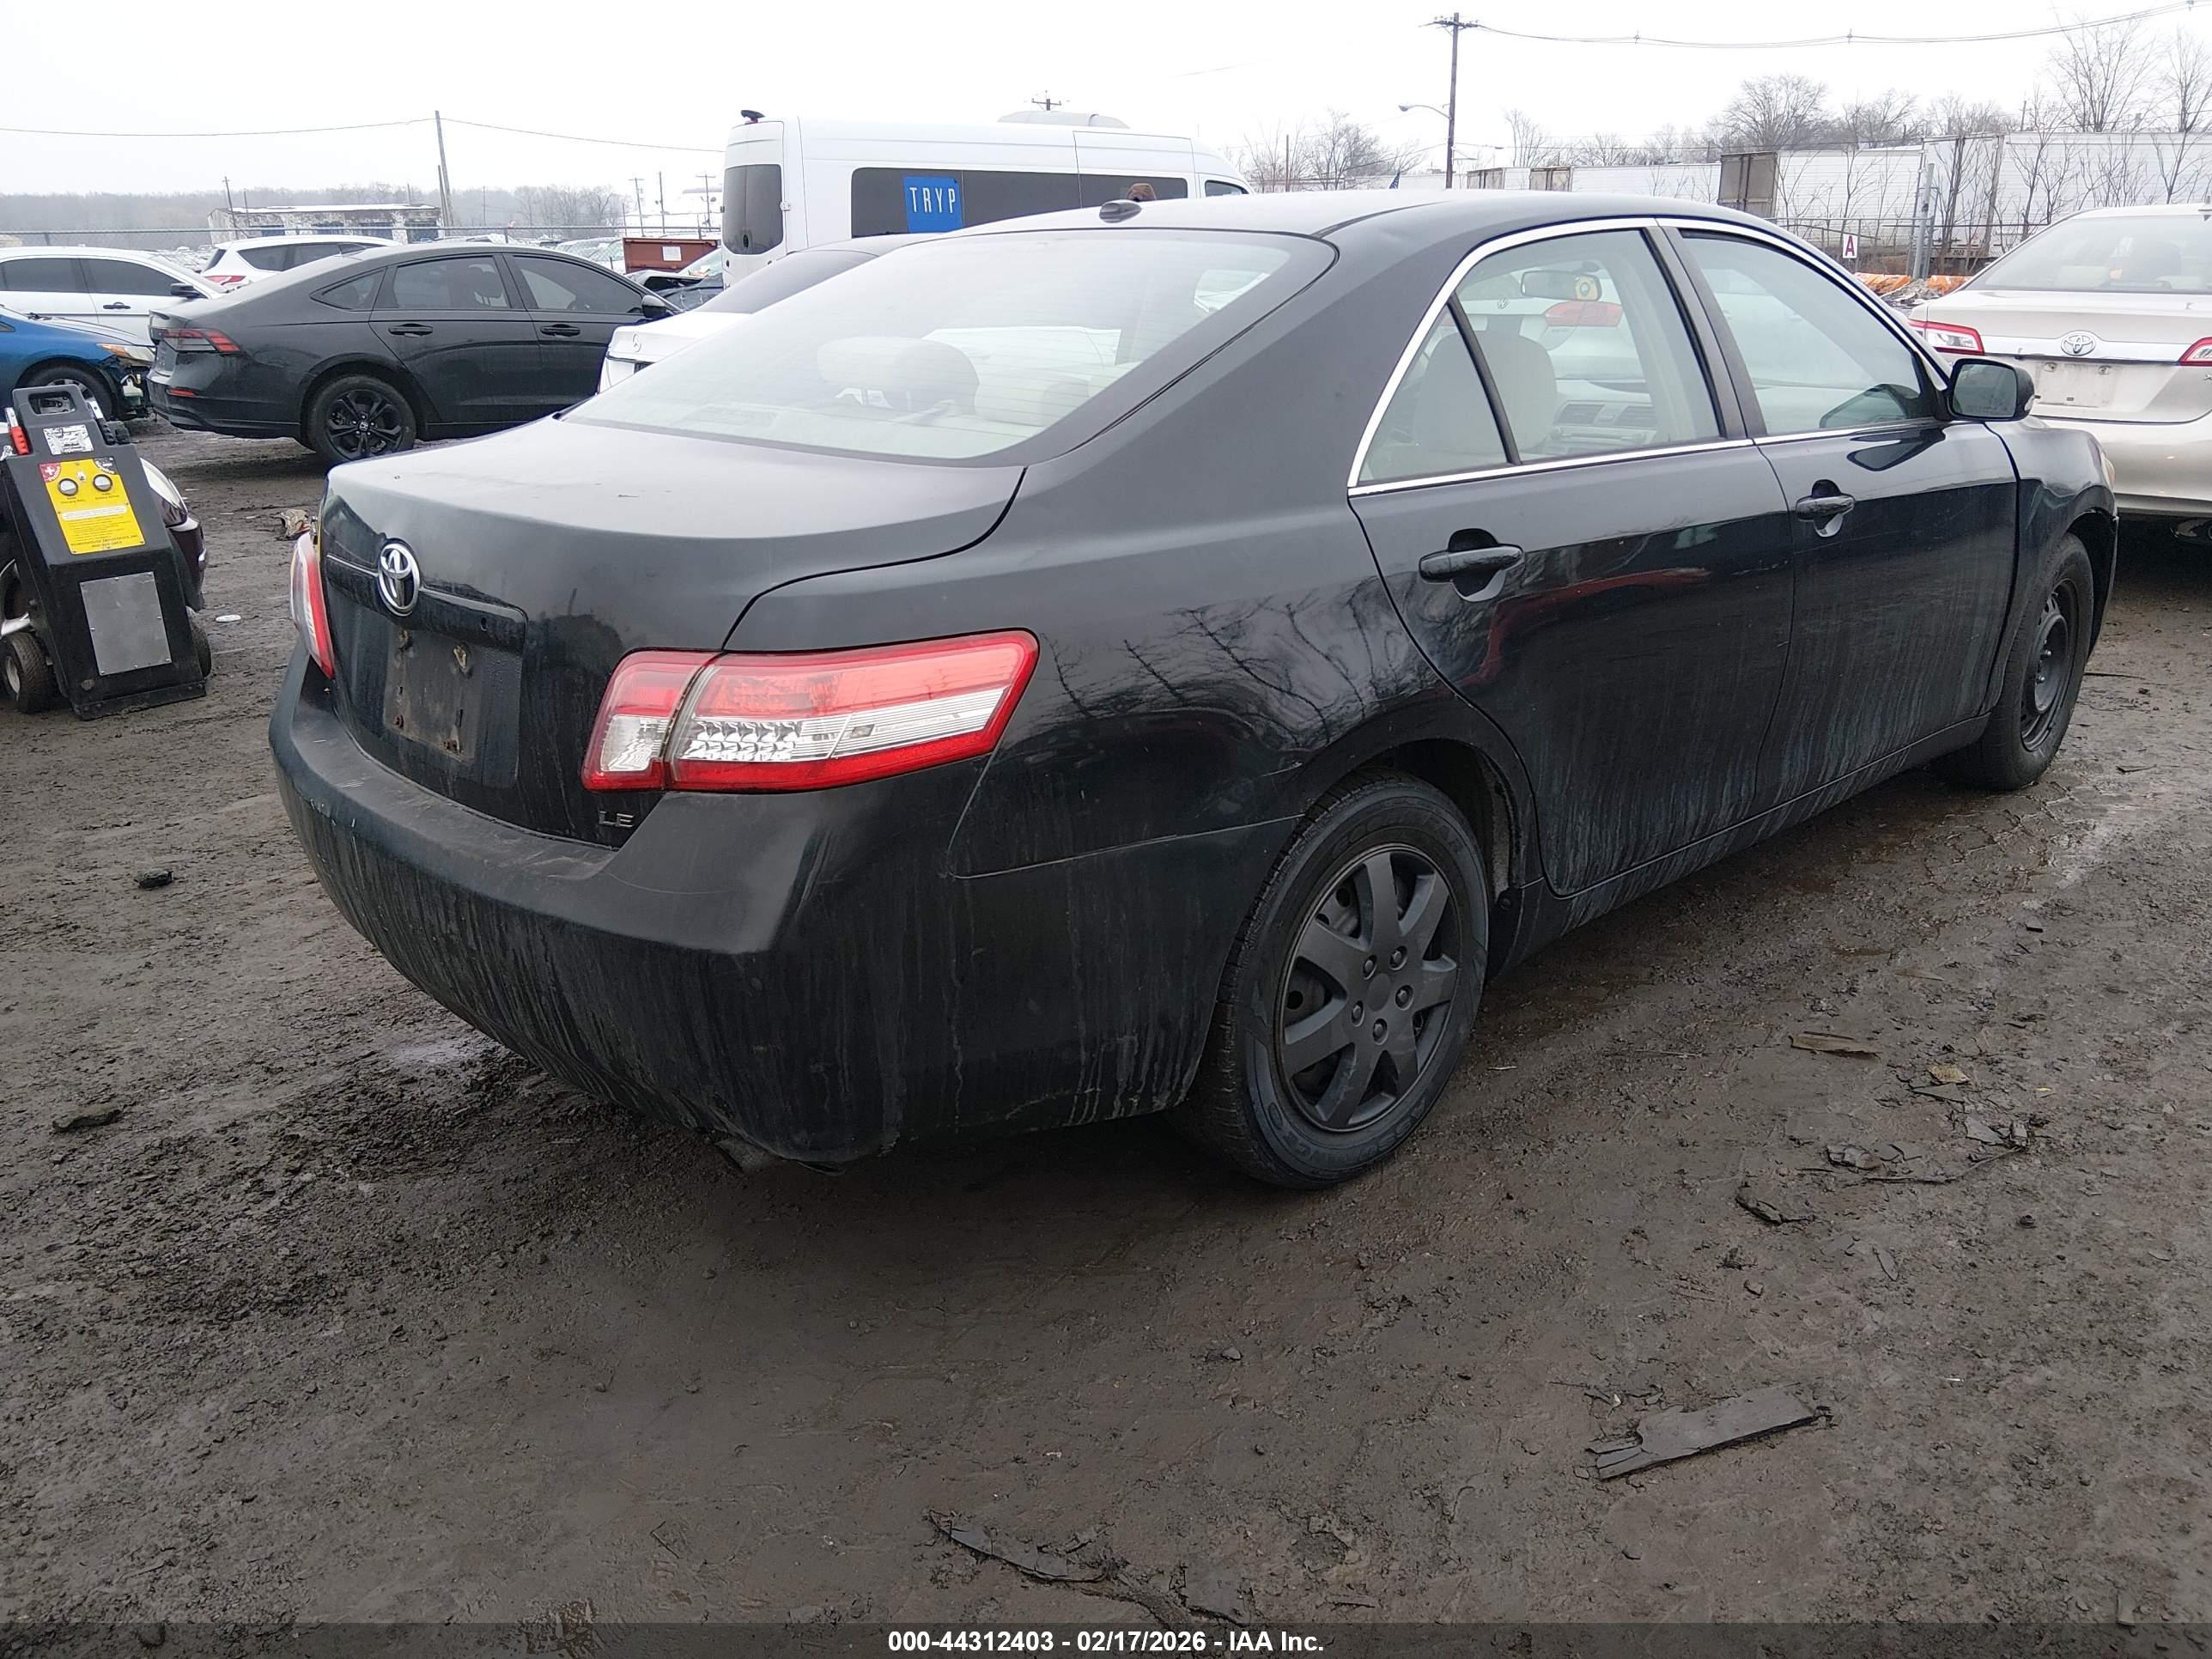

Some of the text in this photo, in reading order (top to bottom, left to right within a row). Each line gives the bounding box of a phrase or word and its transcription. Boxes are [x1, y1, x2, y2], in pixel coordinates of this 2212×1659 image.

[909, 186, 956, 214] TRYP
[1844, 235, 1855, 257] A
[599, 811, 634, 828] LE
